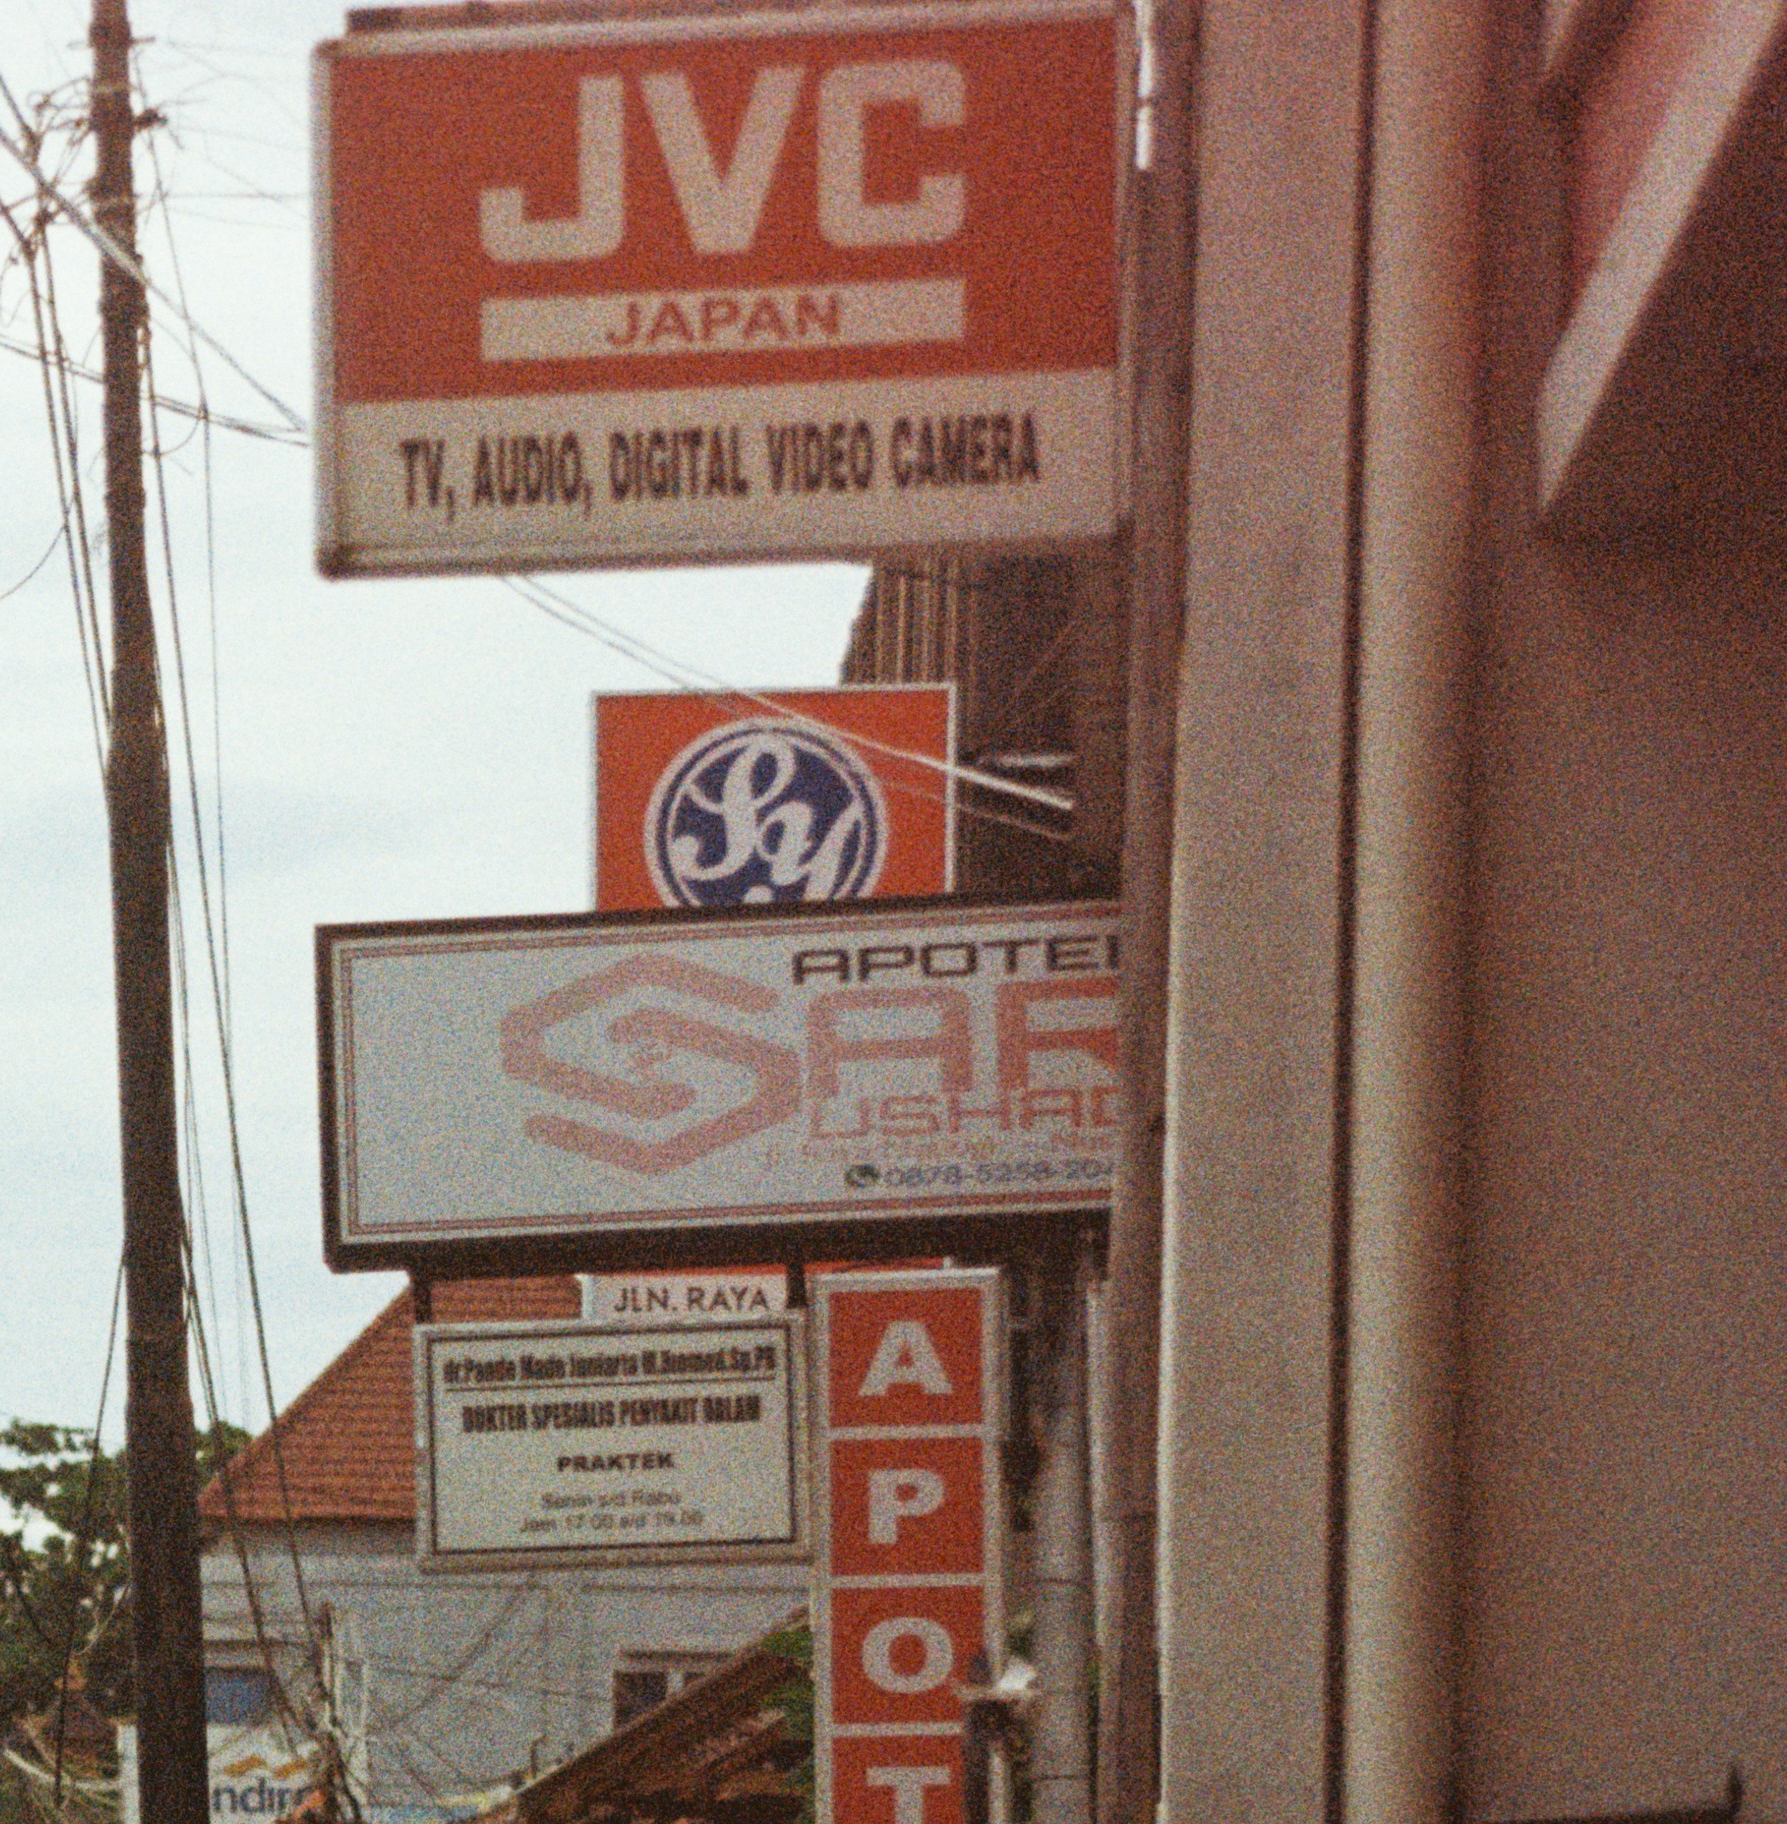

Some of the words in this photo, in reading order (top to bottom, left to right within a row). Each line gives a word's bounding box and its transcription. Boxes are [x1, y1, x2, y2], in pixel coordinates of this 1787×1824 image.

[480, 59, 967, 265] JVC
[606, 294, 841, 346] JAPAN
[400, 437, 456, 520] TV,
[472, 430, 593, 513] AUDIO,
[610, 428, 748, 503] DIGITAL
[767, 421, 875, 497] VIDEO
[891, 413, 1040, 490] CAMERA
[614, 1286, 678, 1314] JLN.
[687, 1285, 771, 1313] RAYA
[556, 1453, 674, 1472] PRAKTEK
